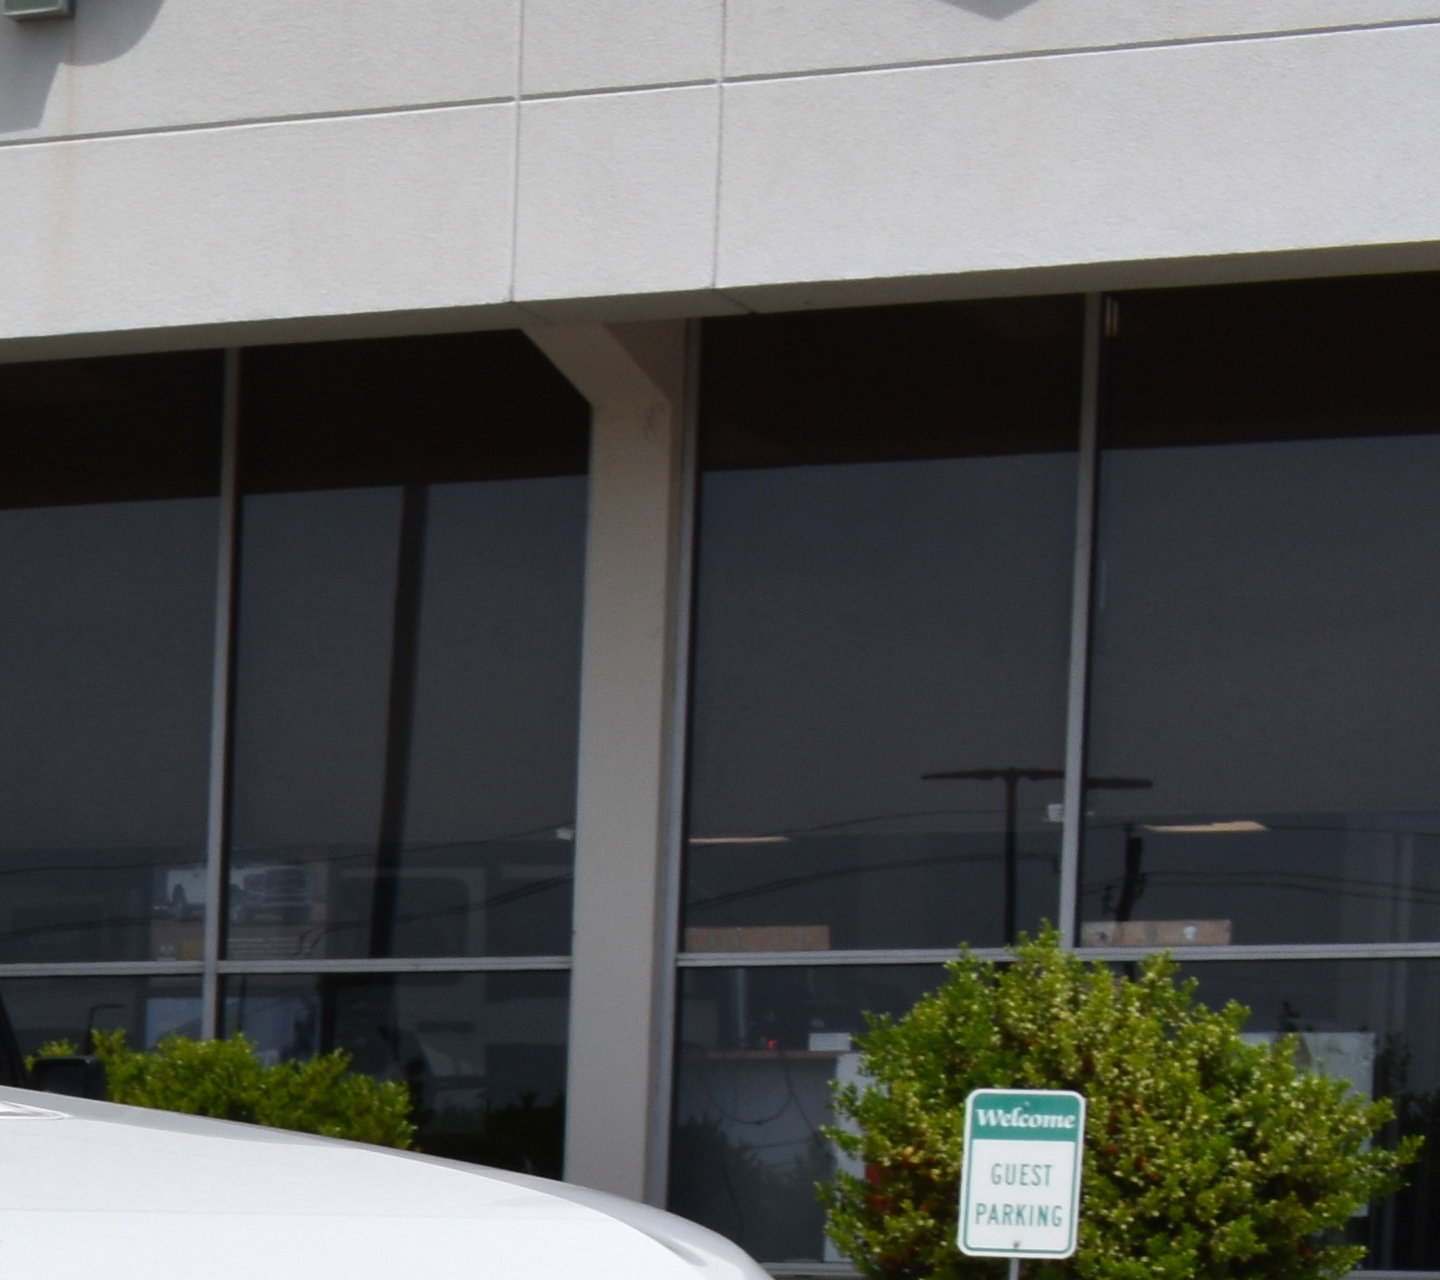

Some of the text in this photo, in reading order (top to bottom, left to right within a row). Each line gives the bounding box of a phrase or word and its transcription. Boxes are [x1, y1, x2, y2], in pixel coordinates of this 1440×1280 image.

[975, 1106, 1076, 1129] Welcome
[990, 1163, 1053, 1187] GUEST
[975, 1203, 1063, 1228] PARKING
